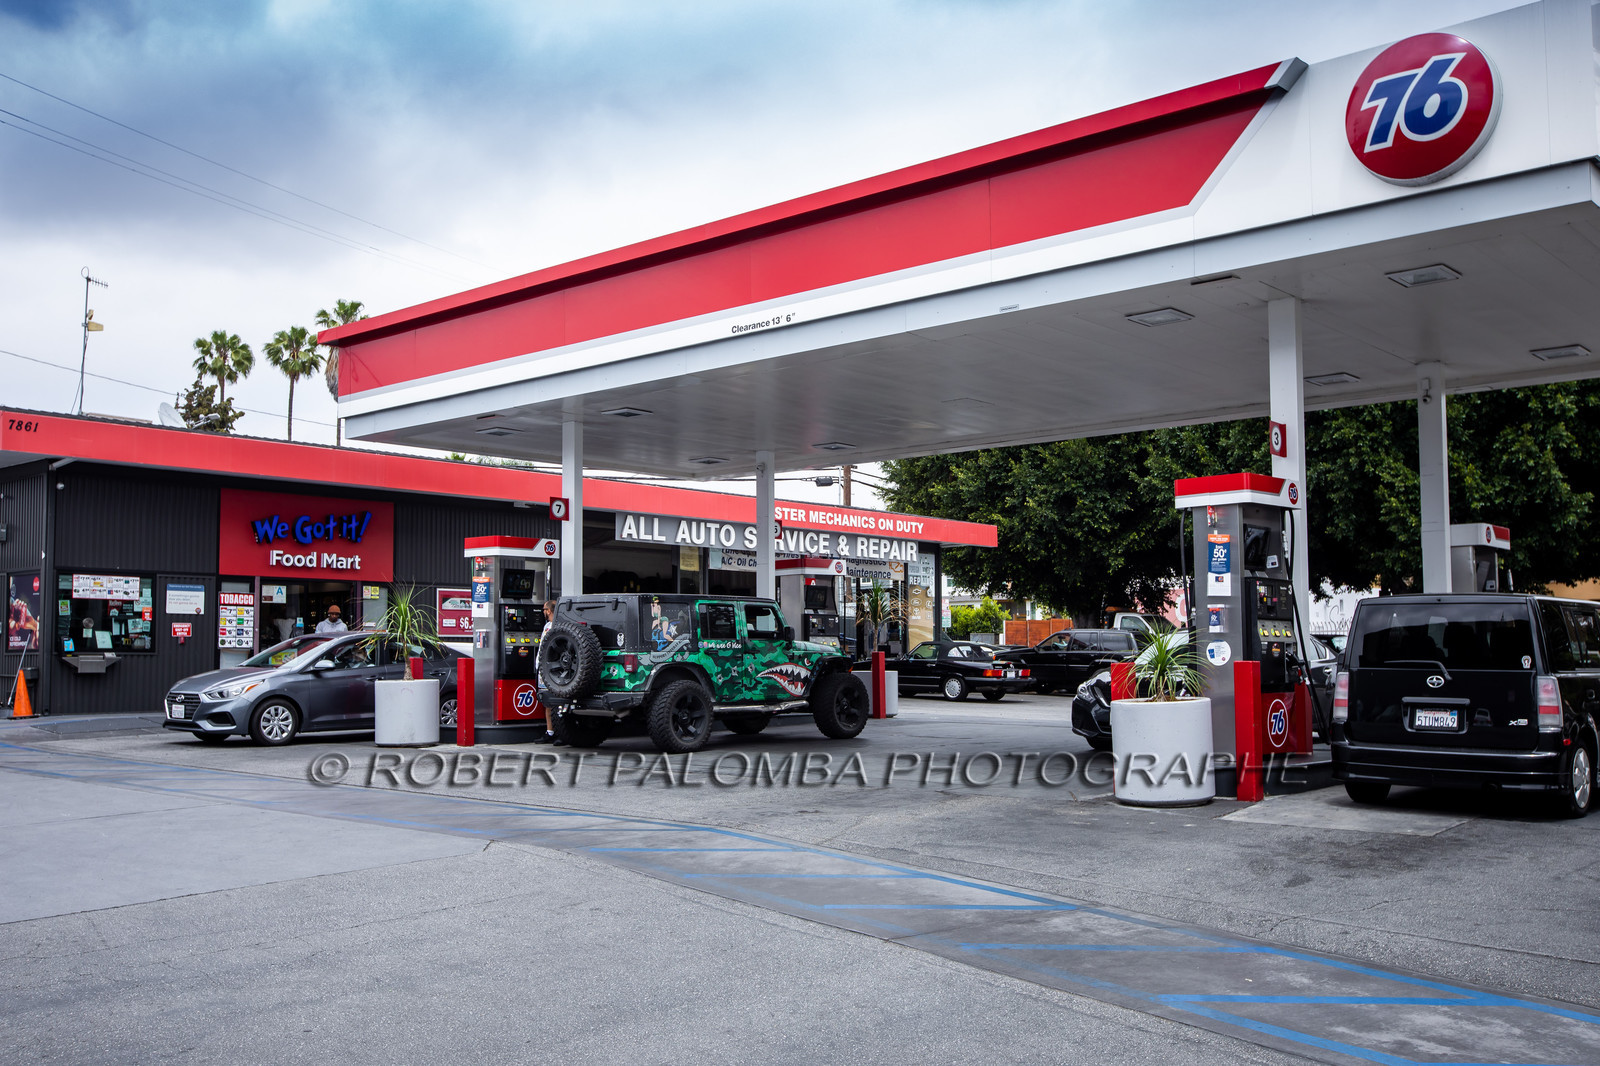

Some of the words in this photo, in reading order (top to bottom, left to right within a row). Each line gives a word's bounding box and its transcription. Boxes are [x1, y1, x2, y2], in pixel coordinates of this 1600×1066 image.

[1360, 52, 1467, 153] 76
[731, 320, 770, 334] Clearance
[8, 419, 39, 433] 7861
[1274, 432, 1280, 445] 3
[1290, 487, 1298, 500] 76
[556, 505, 562, 513] 7
[774, 506, 806, 522] STER
[809, 510, 876, 529] MECHANICS
[878, 518, 893, 531] ON
[896, 520, 924, 534] DUTY
[253, 515, 289, 544] We
[294, 515, 337, 544] Got
[341, 511, 372, 543] it!
[621, 515, 666, 541] ALL
[675, 520, 736, 547] AUTO
[743, 526, 830, 554] SRVICE
[837, 535, 850, 557] &
[856, 537, 918, 562] REPAIR
[545, 543, 555, 552] 76
[270, 550, 317, 568] Food
[321, 553, 361, 570] Mart
[737, 557, 747, 567] Oil
[276, 586, 283, 595] A
[220, 593, 254, 605] TOBACCO
[517, 690, 534, 707] 76
[1271, 710, 1285, 733] 76
[1417, 715, 1456, 728] 5TUM849
